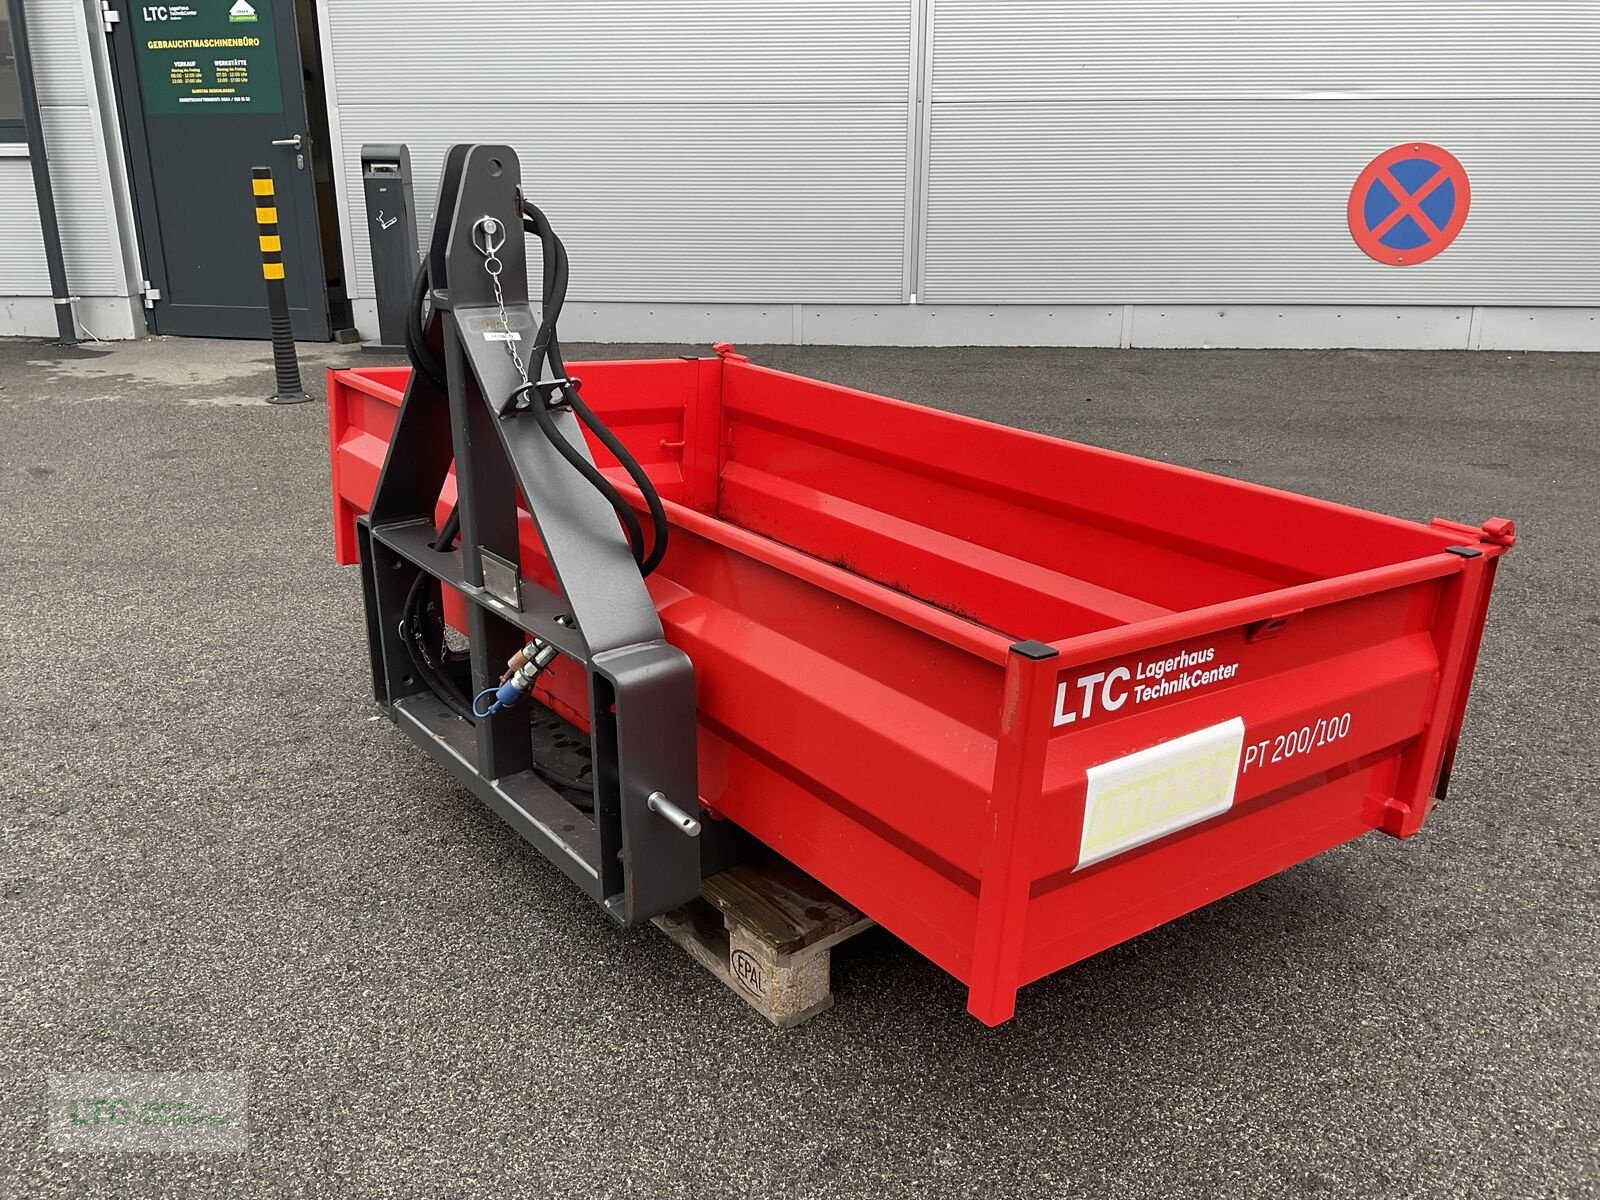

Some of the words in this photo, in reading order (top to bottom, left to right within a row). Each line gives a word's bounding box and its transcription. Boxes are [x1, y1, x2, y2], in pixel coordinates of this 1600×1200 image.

[143, 6, 168, 21] LTC
[148, 37, 259, 48] GEBRAUCHTMASCHINENBÜRO
[1136, 646, 1215, 680] Lagerhaus
[1053, 666, 1130, 727] LTC
[1134, 664, 1239, 704] TechnikCenter
[1243, 740, 1271, 773] PT
[1271, 712, 1351, 764] 200/100
[737, 954, 767, 995] EPAL
